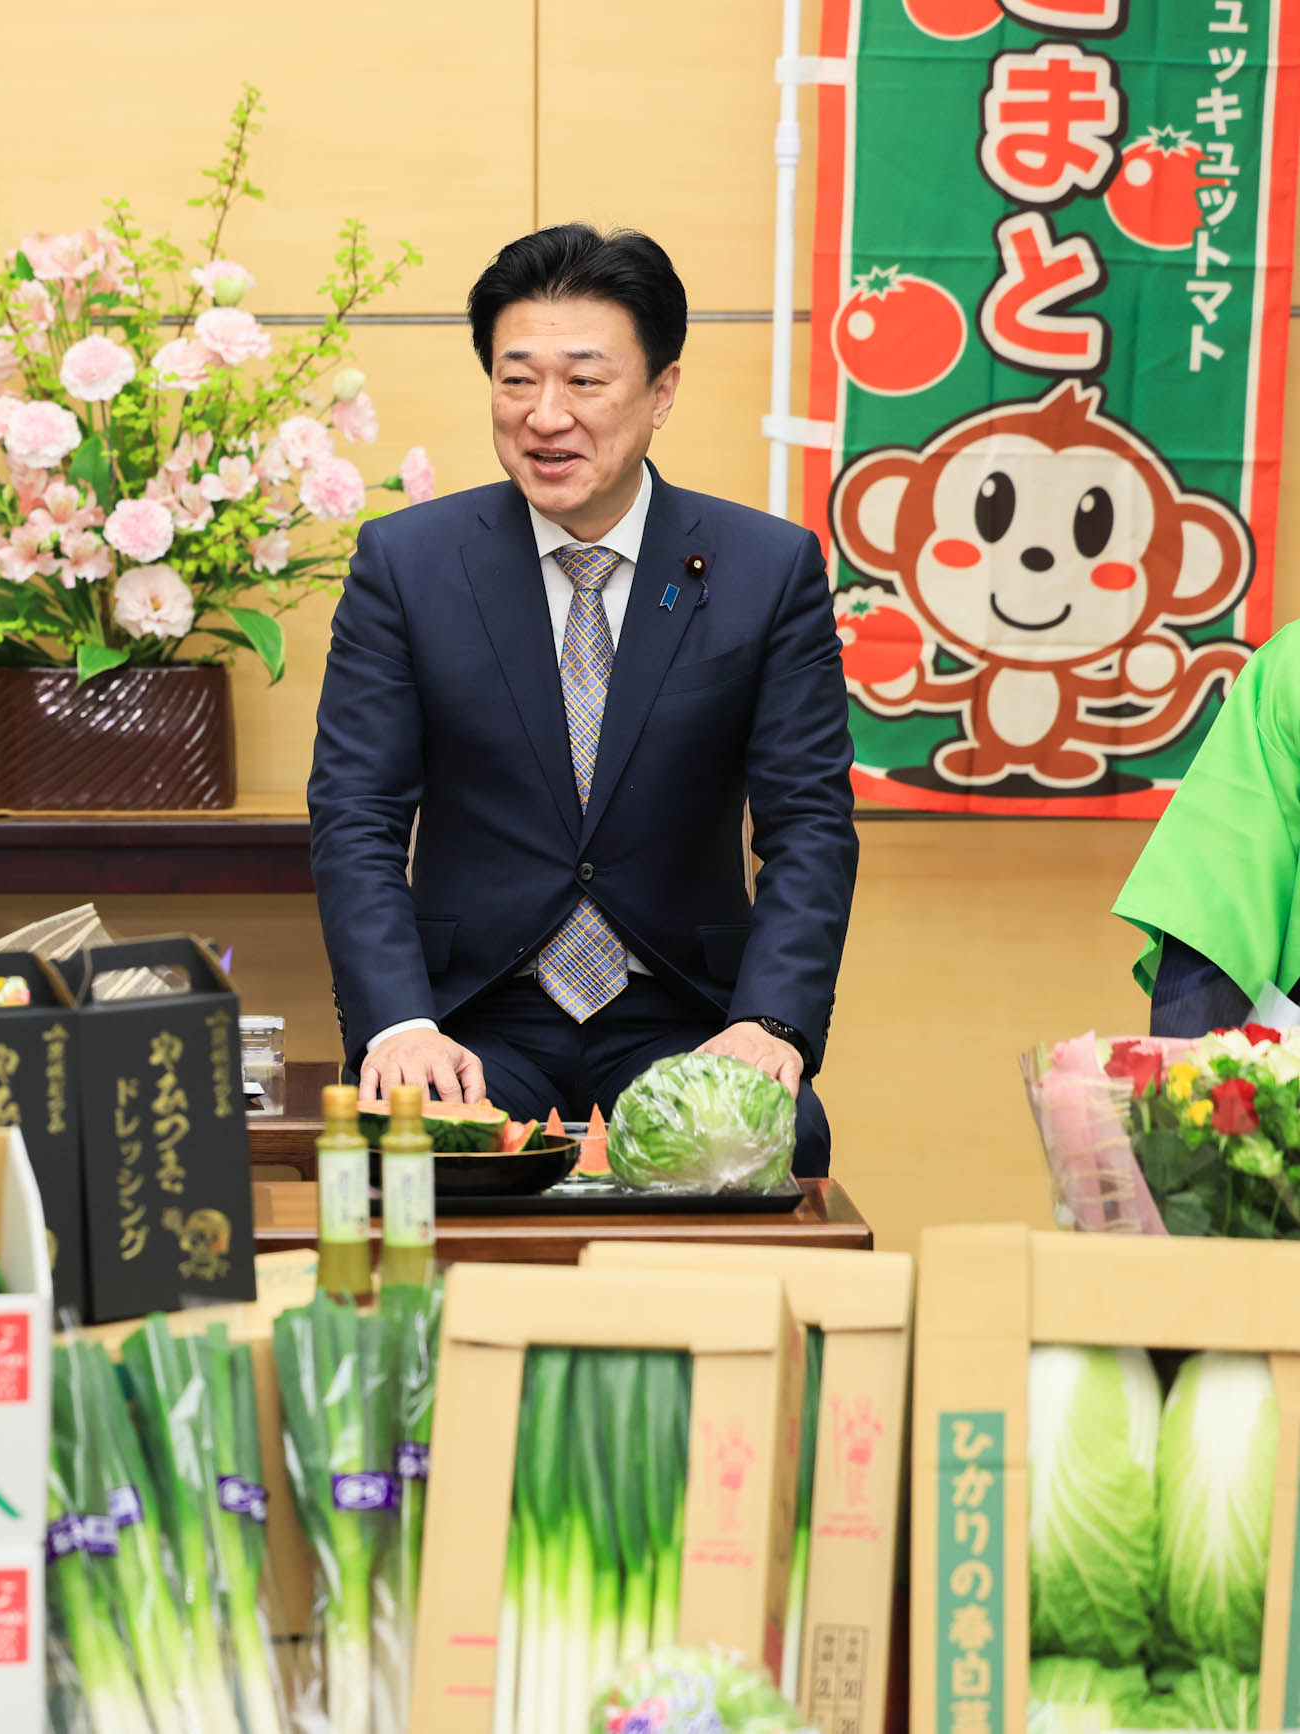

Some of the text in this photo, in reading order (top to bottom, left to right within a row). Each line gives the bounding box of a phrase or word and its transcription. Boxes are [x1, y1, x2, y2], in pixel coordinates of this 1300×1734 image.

[980, 0, 1126, 372] まと
[114, 1076, 151, 1262] ドレッシング
